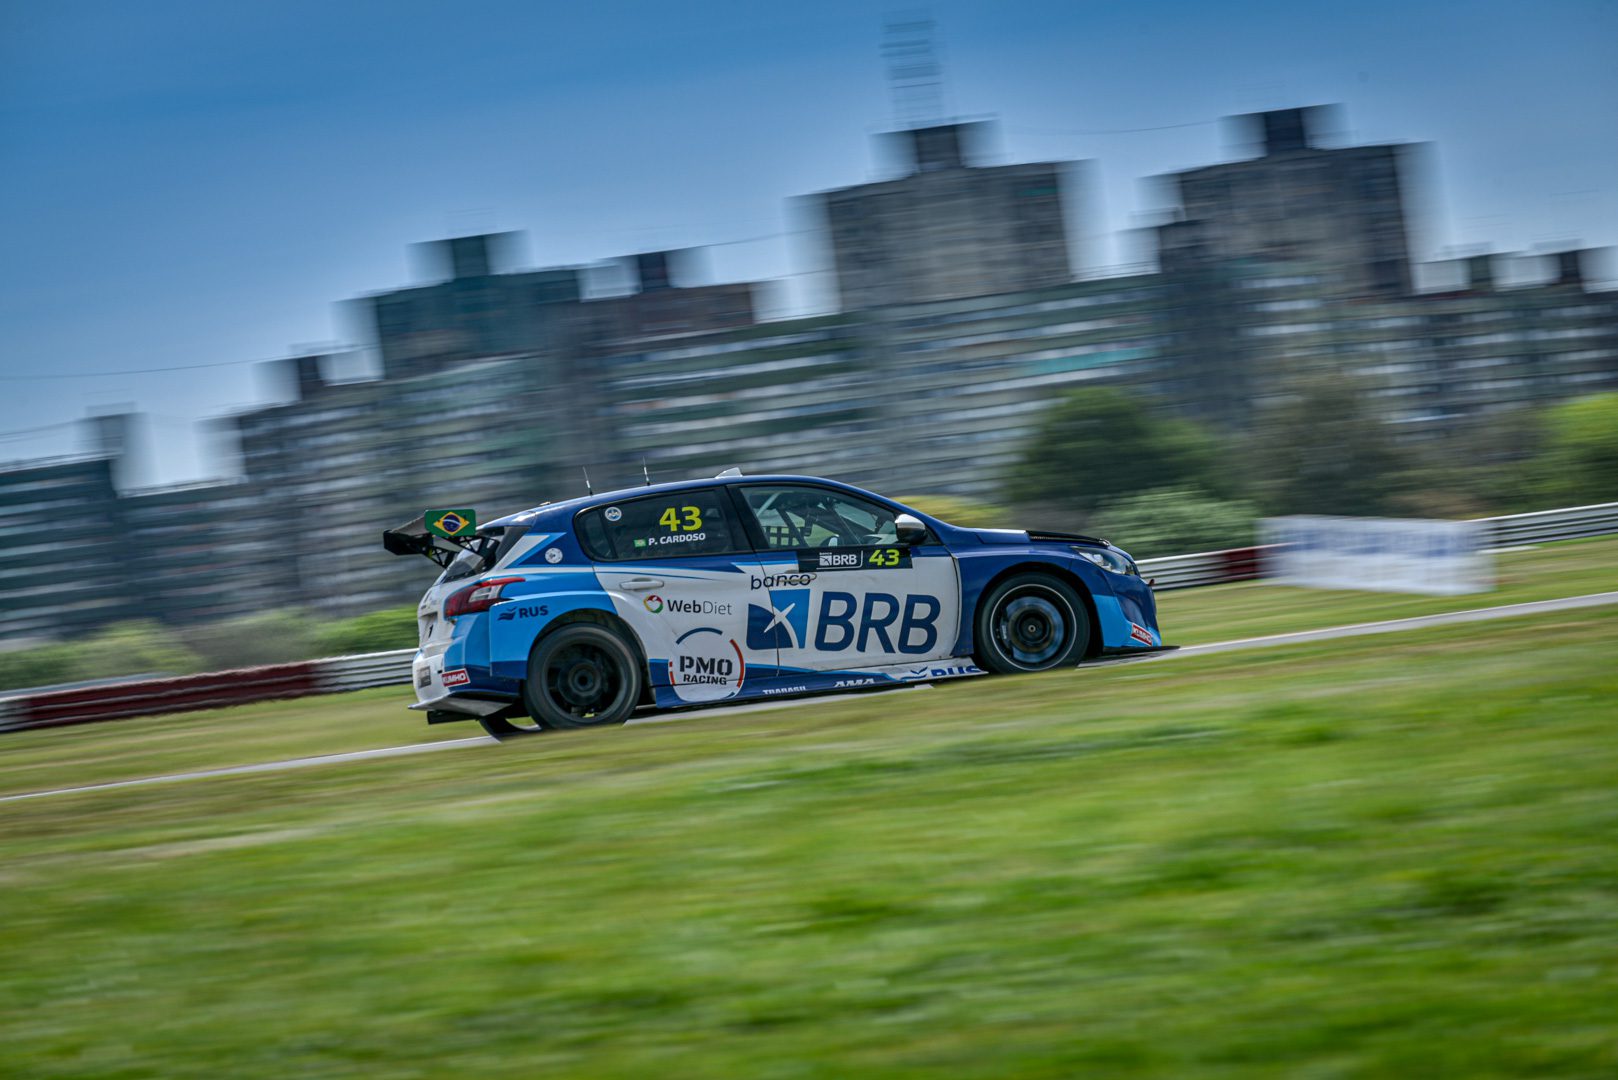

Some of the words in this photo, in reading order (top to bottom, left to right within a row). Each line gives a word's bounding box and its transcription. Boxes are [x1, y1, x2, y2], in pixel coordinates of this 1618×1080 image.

[659, 506, 703, 532] 43
[648, 538, 658, 546] P.
[660, 533, 706, 545] CARDOSO
[833, 554, 857, 566] BRB
[868, 549, 900, 566] 43
[751, 573, 811, 590] banco
[519, 605, 549, 619] RUS
[667, 599, 732, 616] WebDiet
[814, 591, 941, 655] BRB
[679, 655, 733, 677] PMO
[683, 674, 727, 686] RACING
